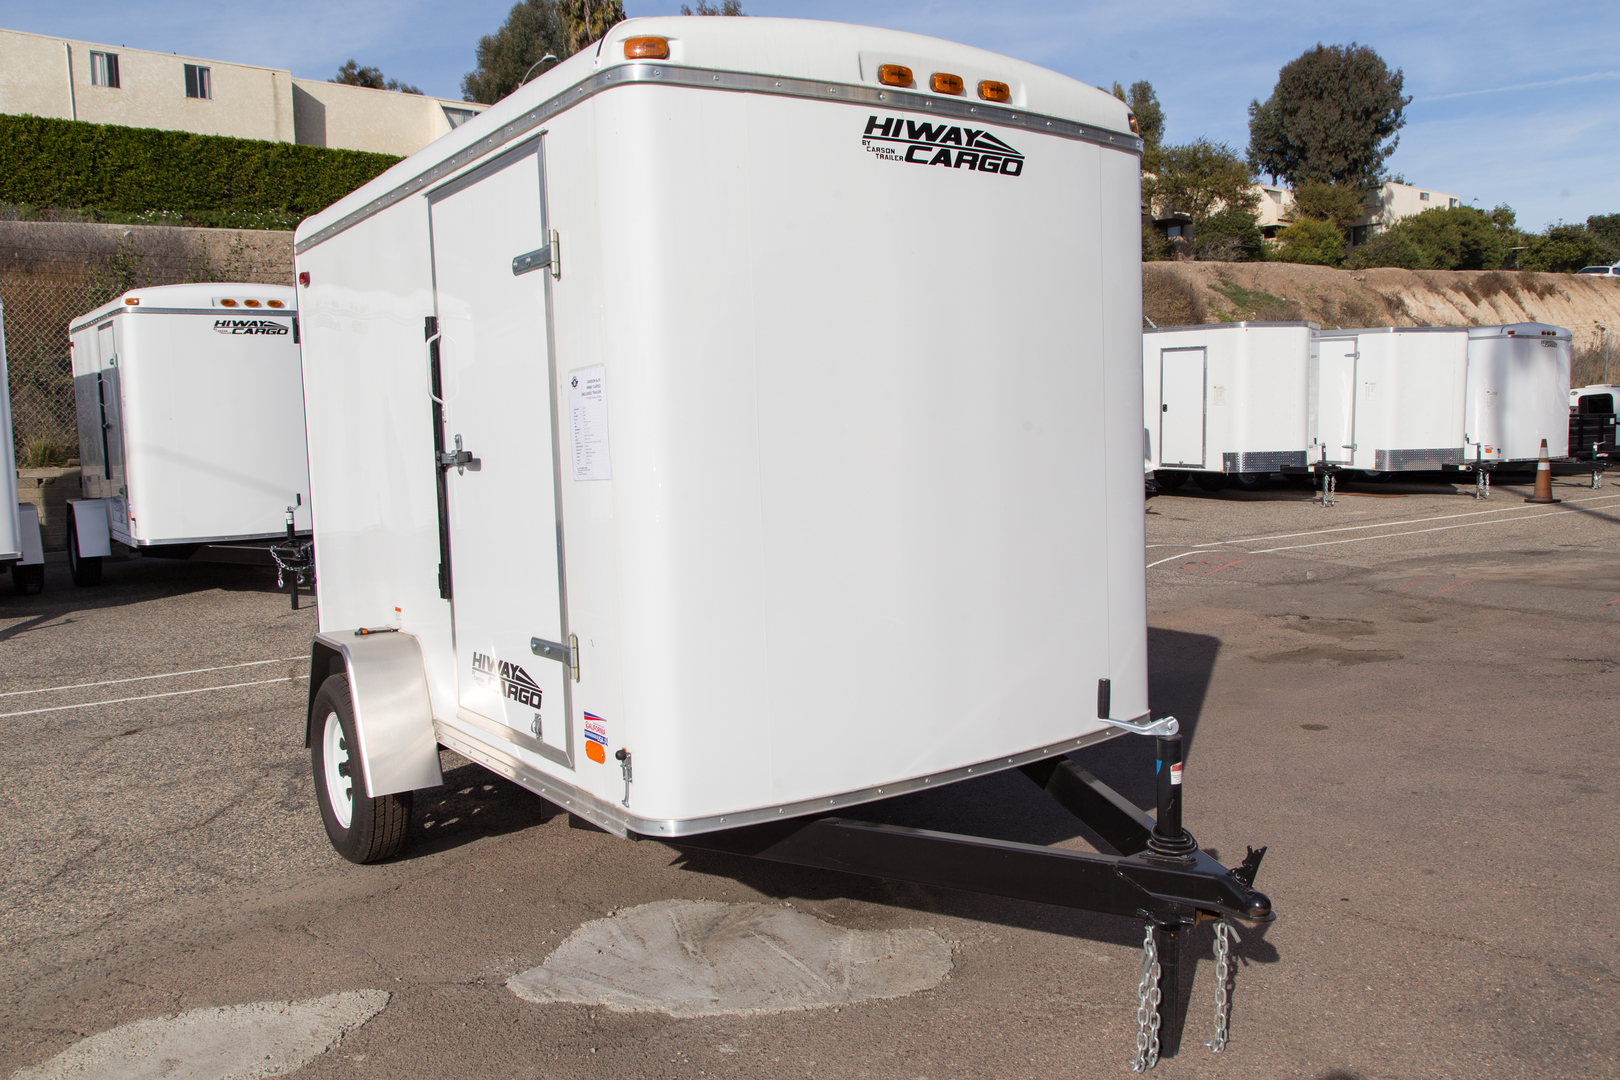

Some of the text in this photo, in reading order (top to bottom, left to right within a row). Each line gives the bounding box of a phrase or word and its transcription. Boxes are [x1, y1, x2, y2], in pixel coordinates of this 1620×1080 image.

[863, 115, 985, 147] HIWAY
[866, 146, 896, 155] CARSON
[875, 153, 904, 162] TRAILER
[904, 144, 1024, 177] CARGO
[472, 651, 520, 680] HIWAY
